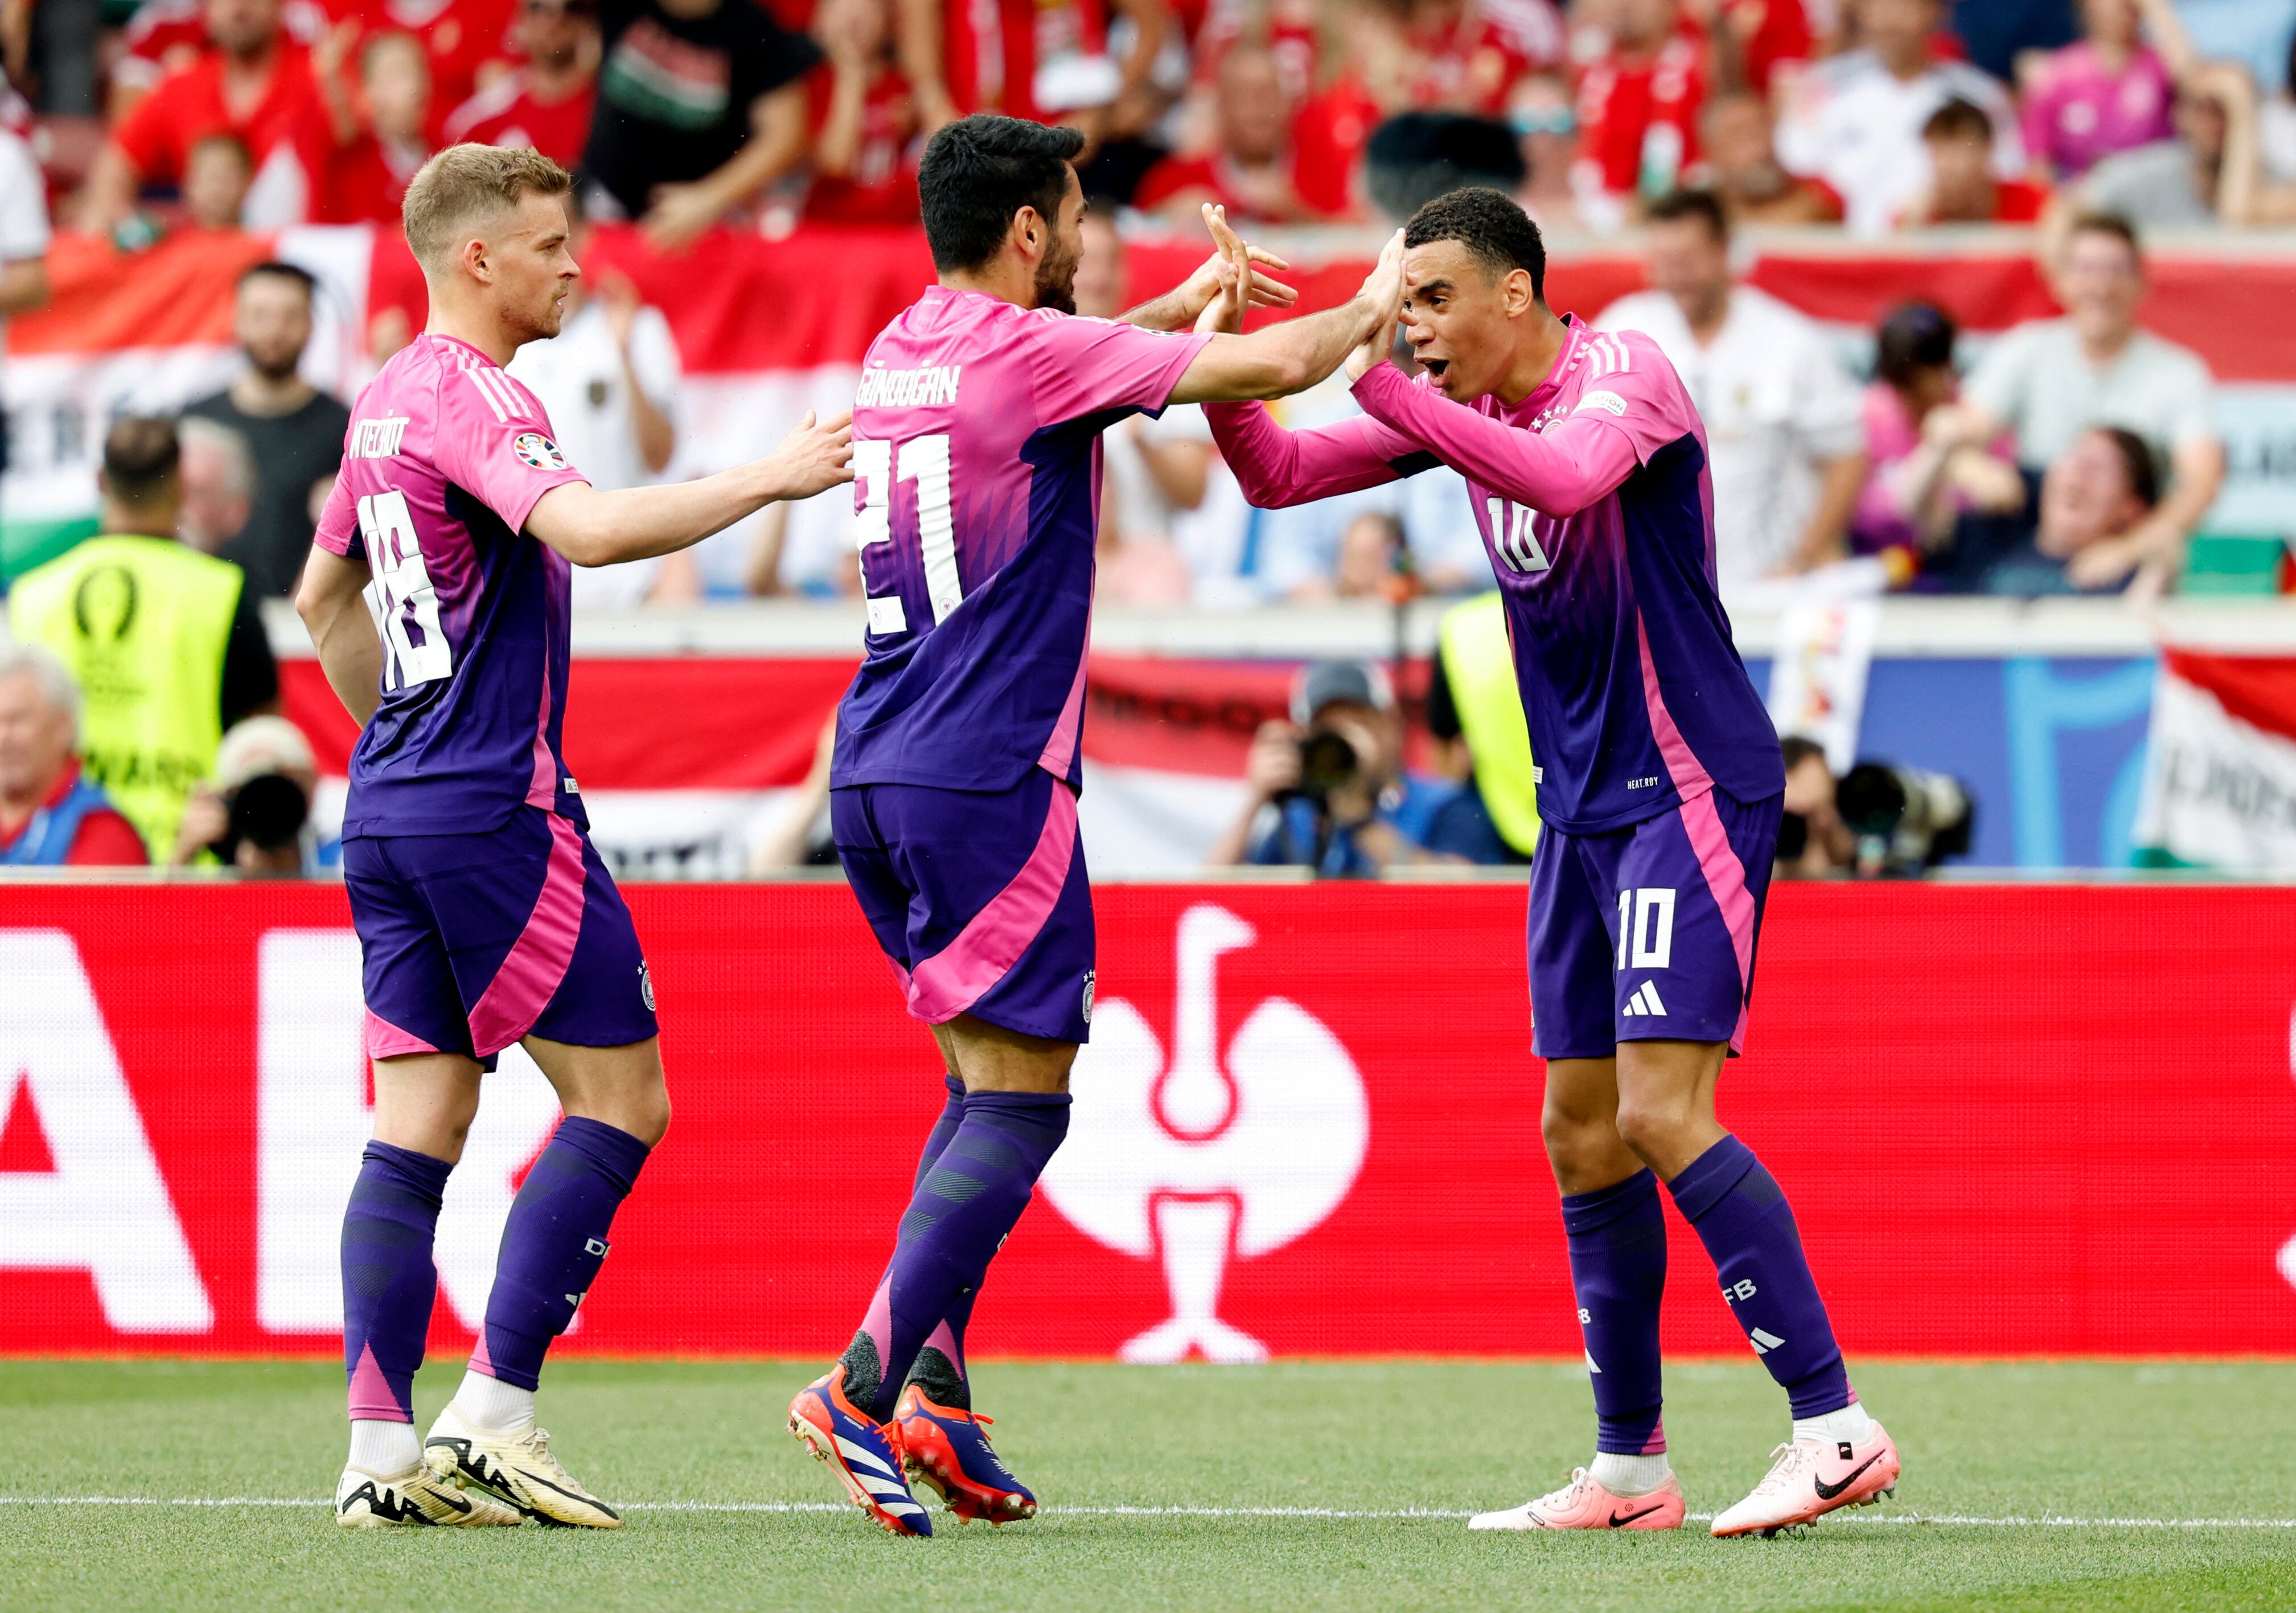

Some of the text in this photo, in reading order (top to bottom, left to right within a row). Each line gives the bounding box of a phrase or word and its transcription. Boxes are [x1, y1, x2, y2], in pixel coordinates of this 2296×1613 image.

[356, 489, 453, 692] 18
[853, 434, 964, 635] 21
[1487, 497, 1550, 573] 10
[1617, 888, 1677, 970] 10
